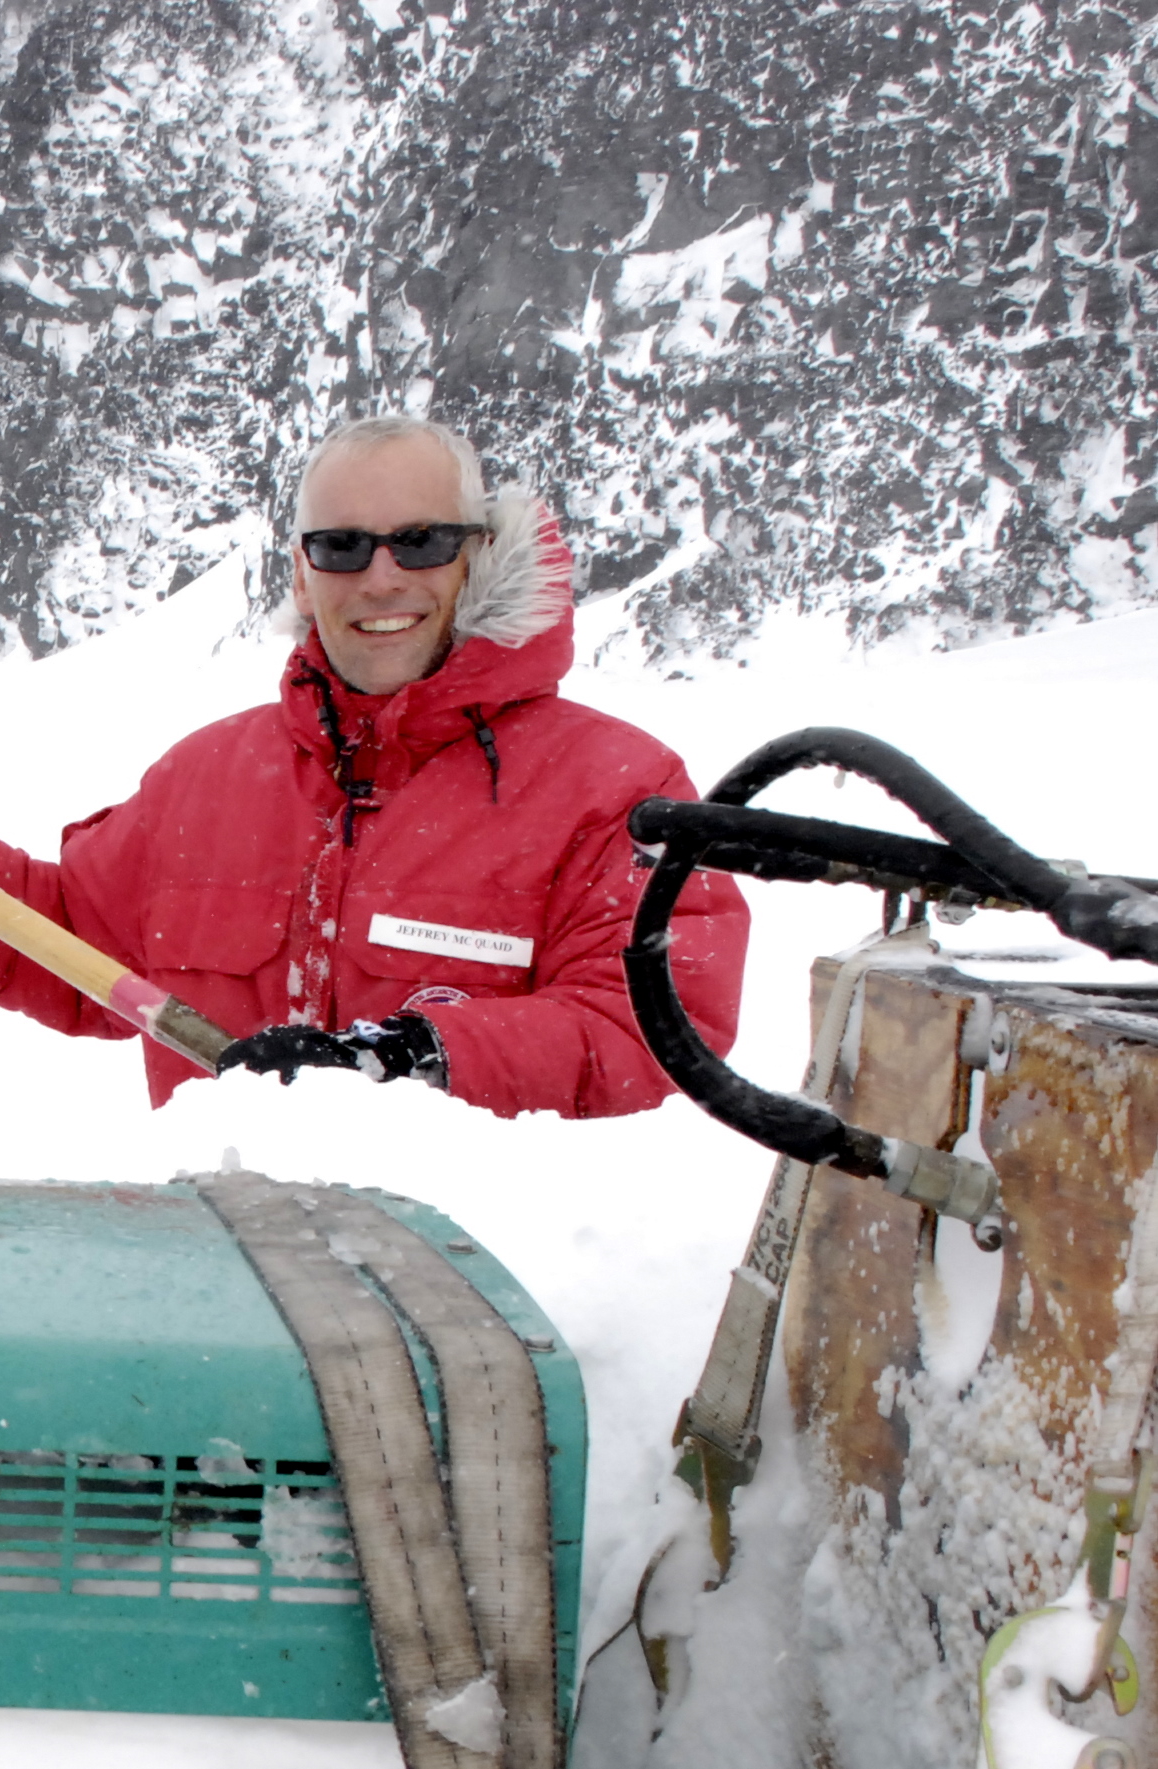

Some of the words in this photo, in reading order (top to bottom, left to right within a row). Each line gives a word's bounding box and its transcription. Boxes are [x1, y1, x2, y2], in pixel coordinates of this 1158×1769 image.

[396, 924, 450, 942] JEFFREY
[453, 934, 473, 946] MC
[474, 938, 513, 953] QUAID
[764, 1217, 790, 1285] CAP
